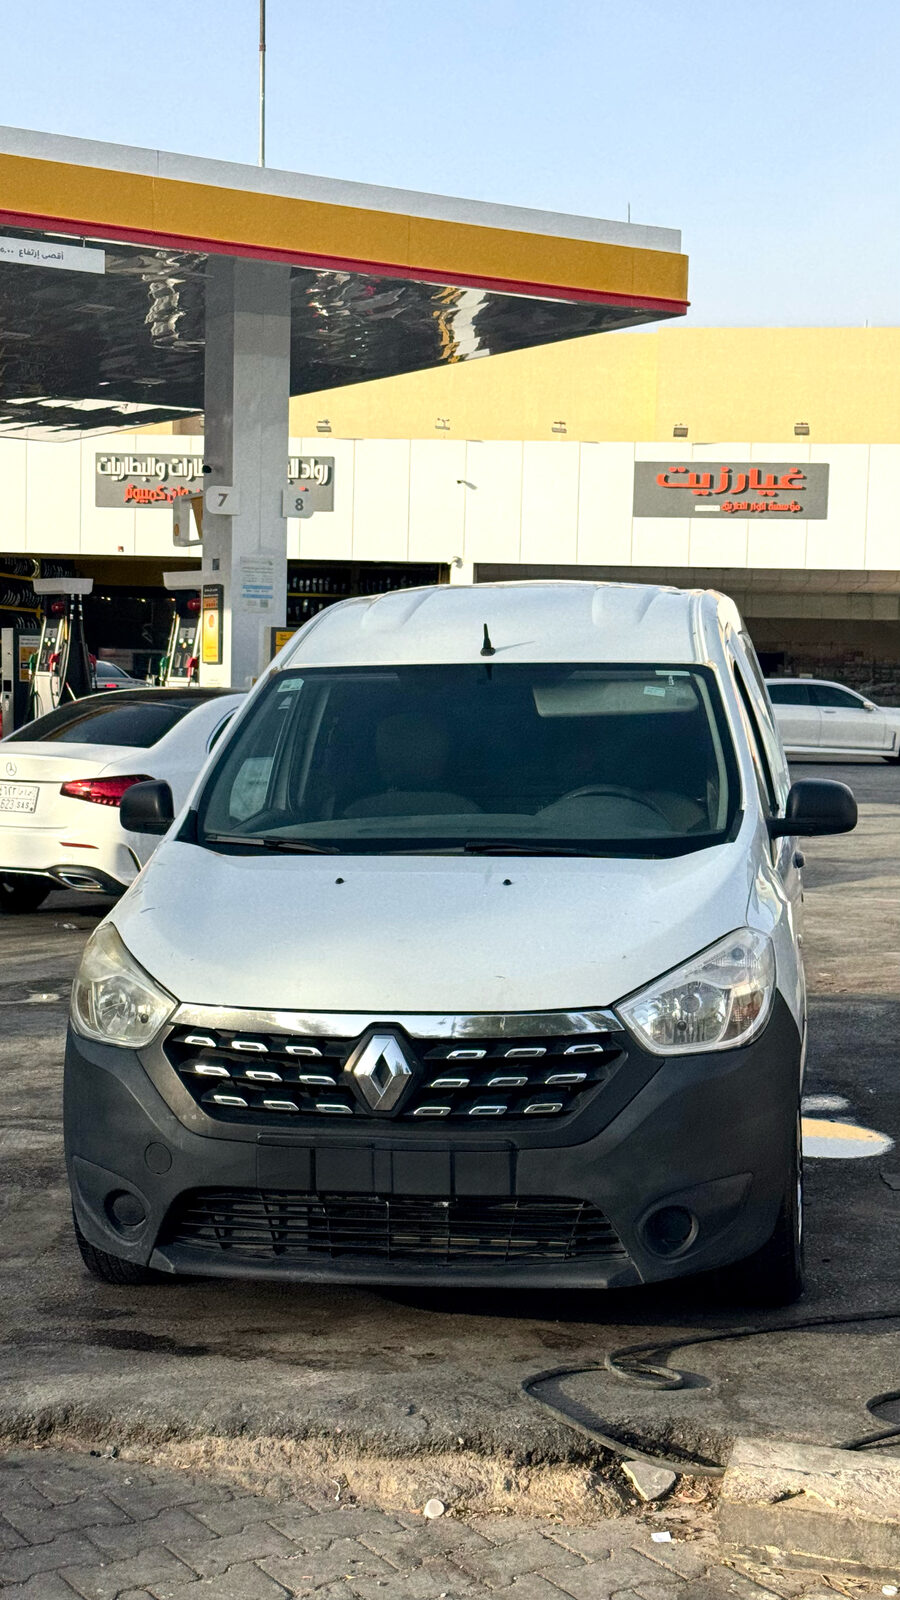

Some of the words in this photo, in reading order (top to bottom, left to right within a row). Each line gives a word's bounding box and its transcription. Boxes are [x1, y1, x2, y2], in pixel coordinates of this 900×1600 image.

[97, 456, 166, 481] والبطاريات
[300, 458, 329, 485] رواد
[656, 466, 729, 495] زيت
[729, 467, 804, 496] غيار
[218, 493, 228, 507] 7
[295, 498, 304, 511] 8
